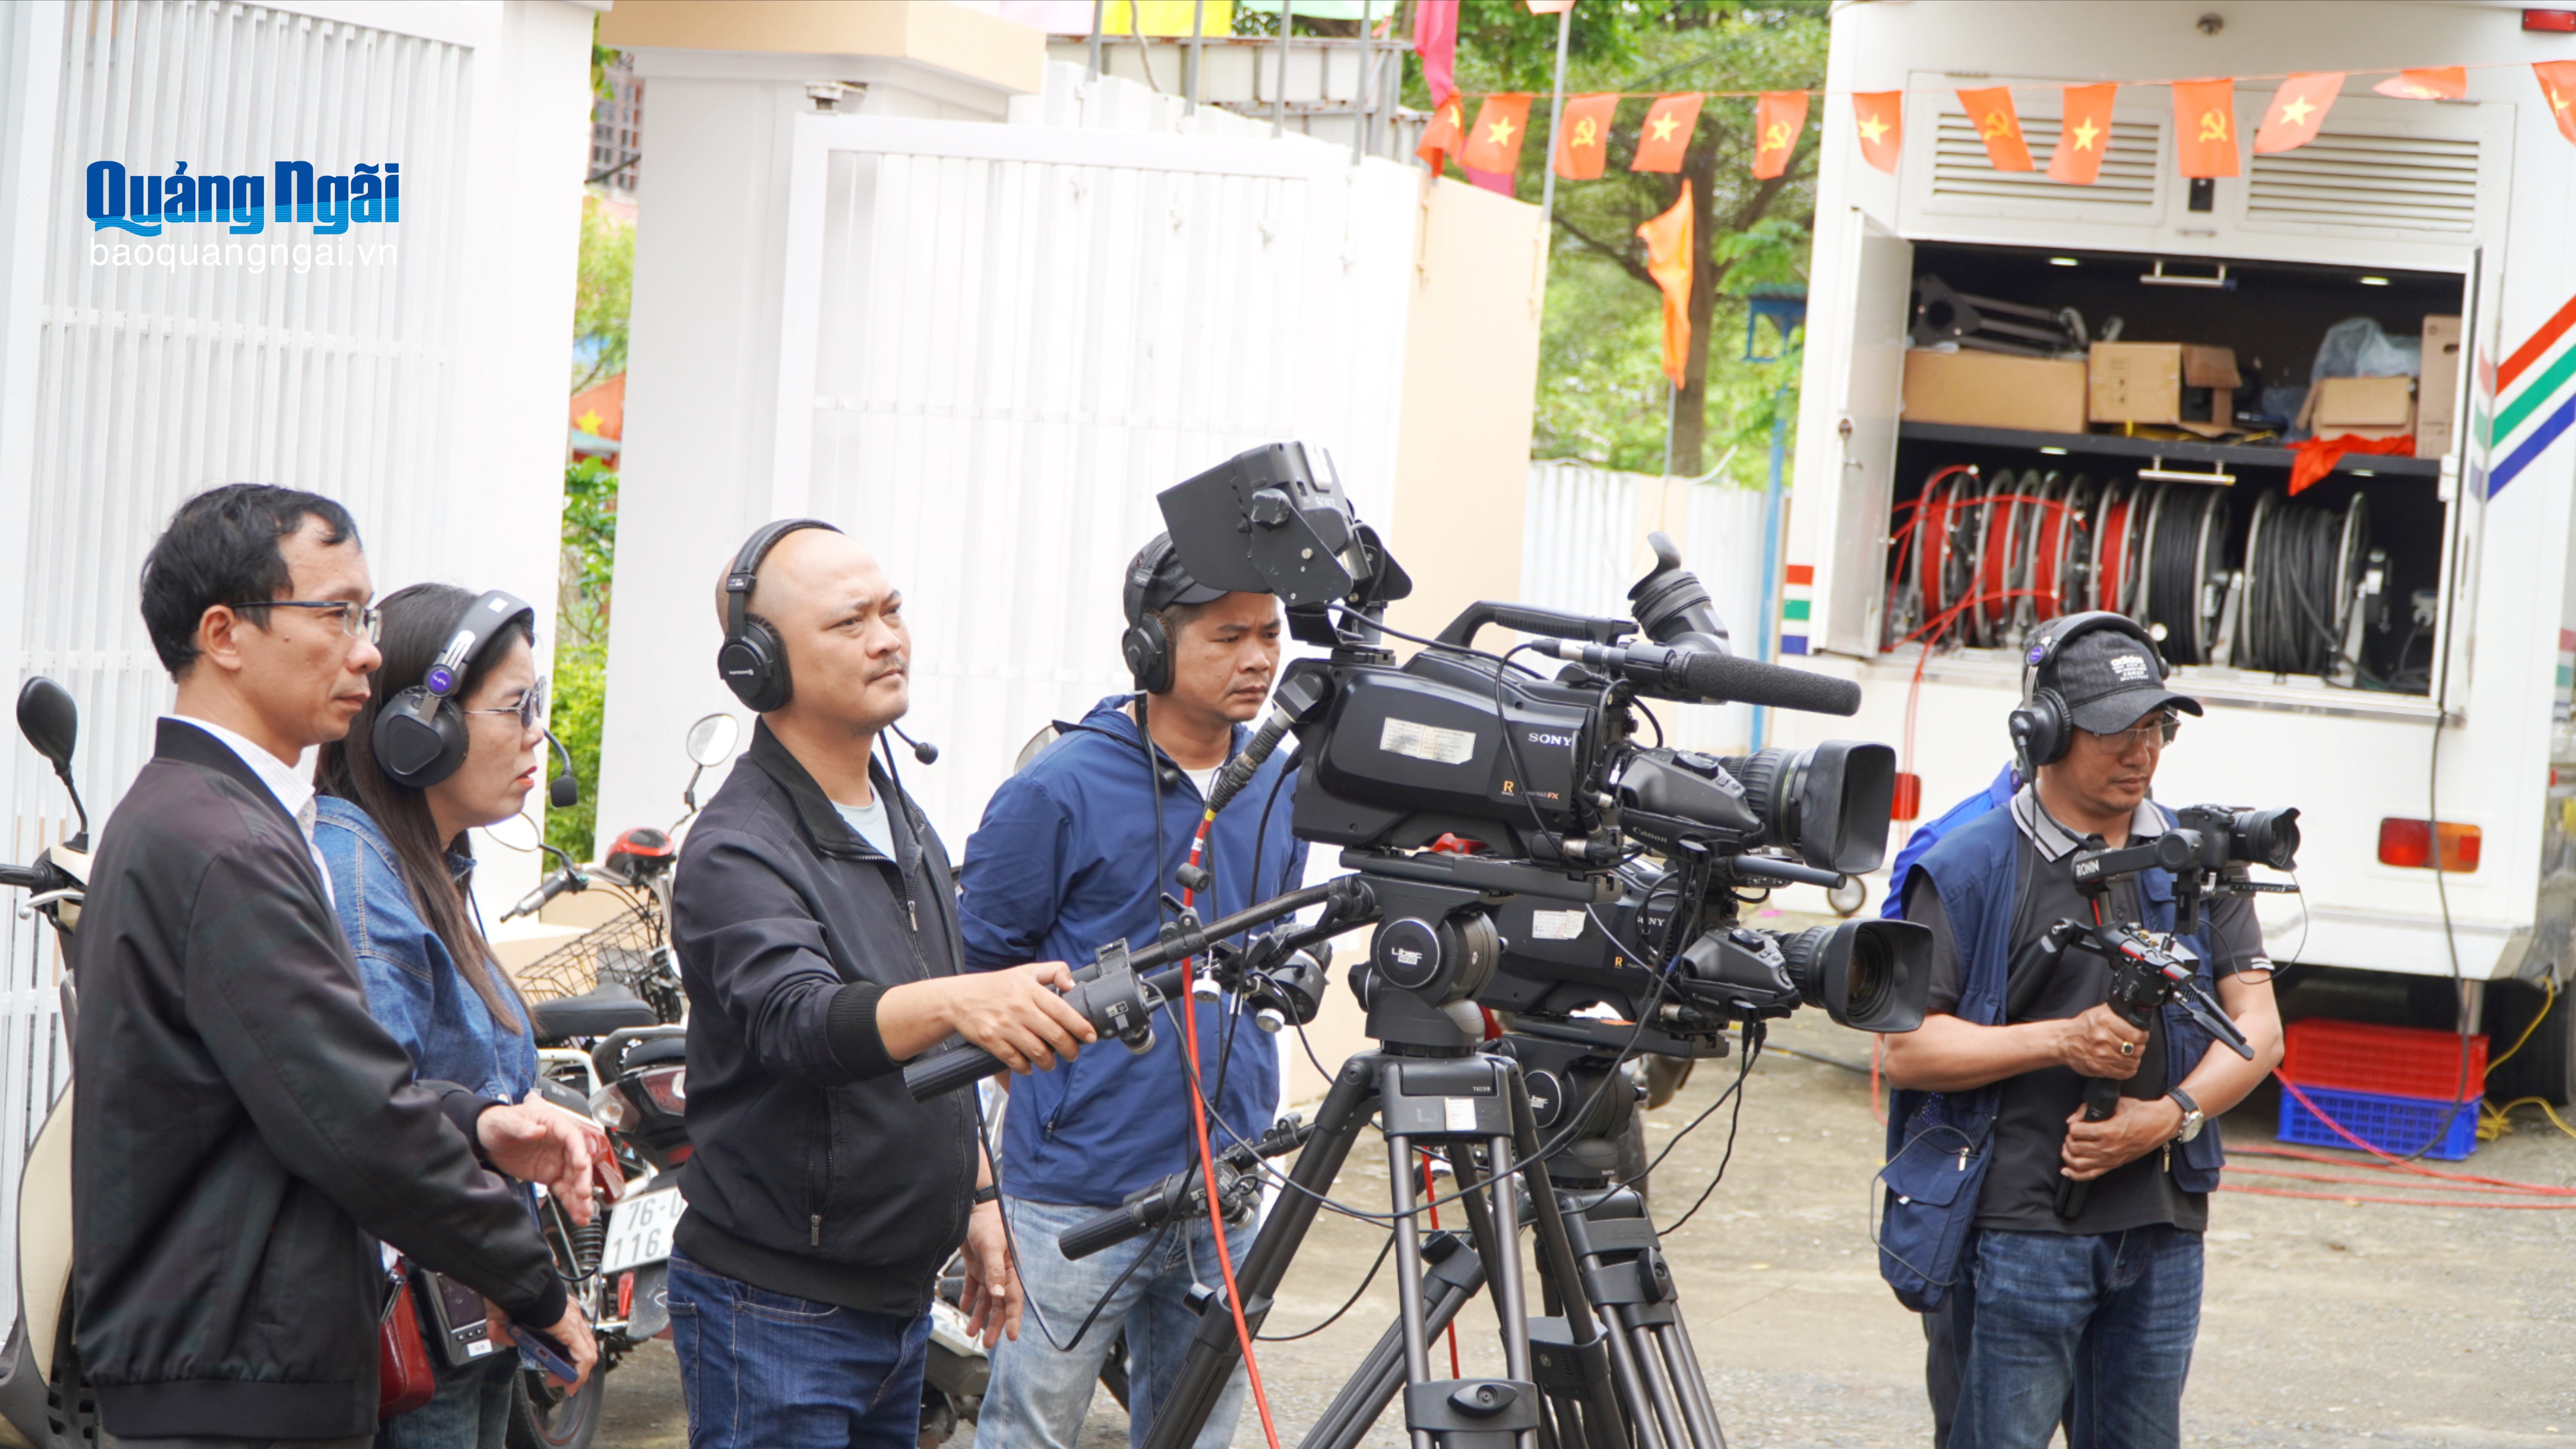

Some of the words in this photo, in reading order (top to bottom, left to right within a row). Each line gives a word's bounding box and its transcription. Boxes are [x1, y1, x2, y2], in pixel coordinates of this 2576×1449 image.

[1528, 732, 1572, 746] SONY
[1503, 781, 1514, 793] R
[1633, 827, 1668, 843] Canon
[2076, 859, 2100, 877] RONIN
[1692, 992, 1719, 1006] Canon
